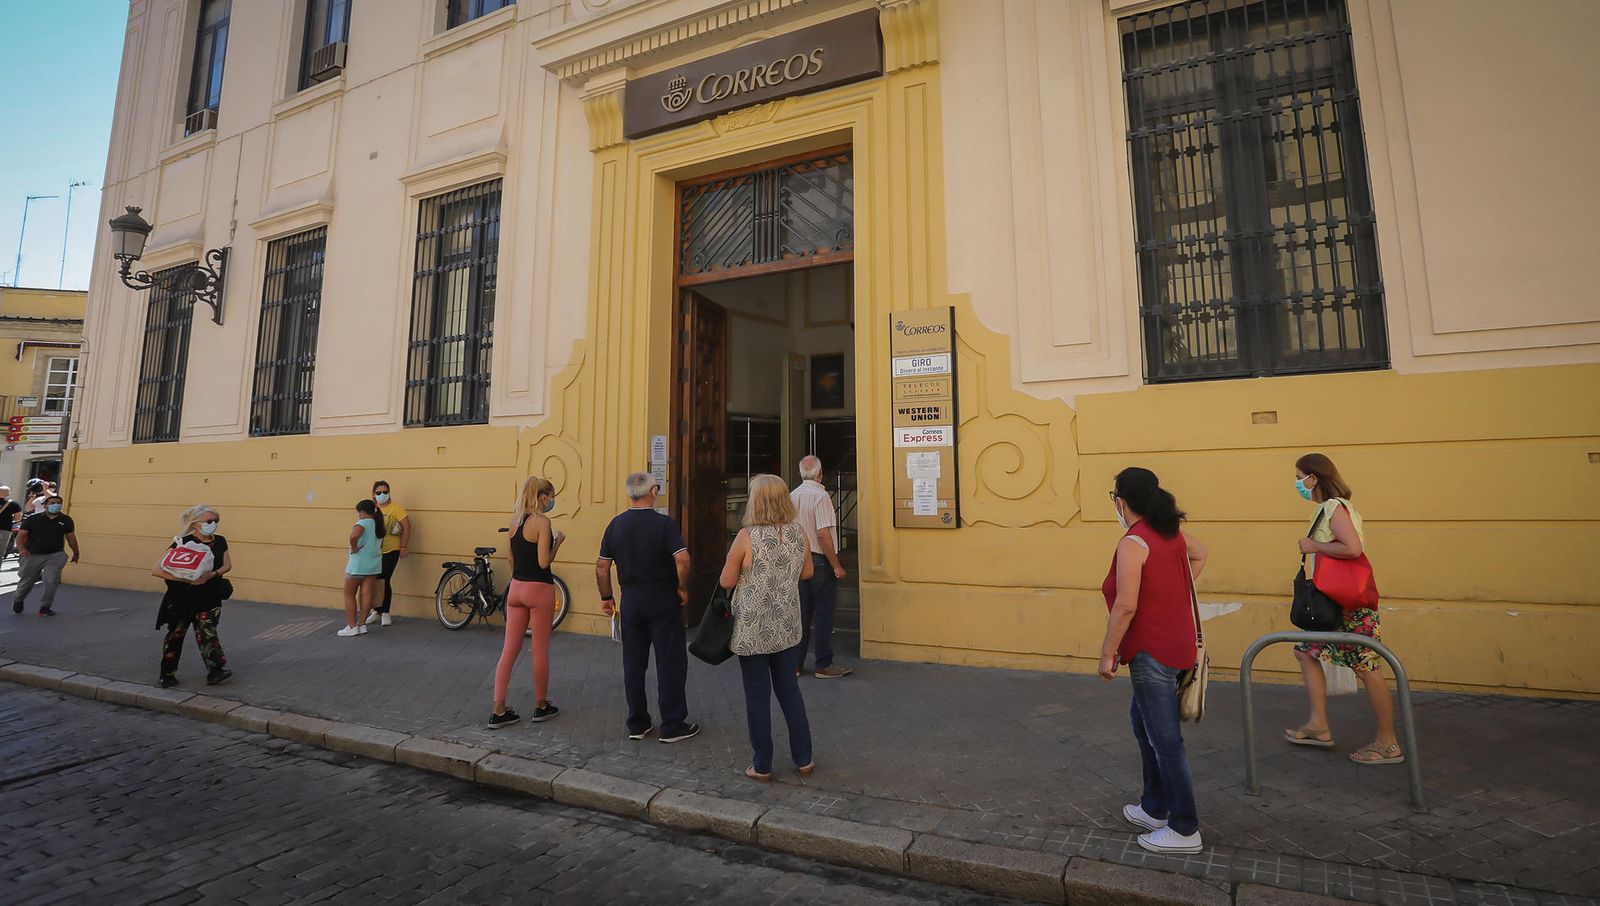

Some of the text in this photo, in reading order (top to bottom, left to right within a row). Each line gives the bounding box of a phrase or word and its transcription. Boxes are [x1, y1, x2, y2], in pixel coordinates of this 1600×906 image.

[695, 47, 825, 105] CORREOS
[903, 323, 946, 337] CORREOS
[911, 358, 932, 368] GIRO
[898, 406, 940, 415] WESTERN
[903, 433, 943, 444] Express
